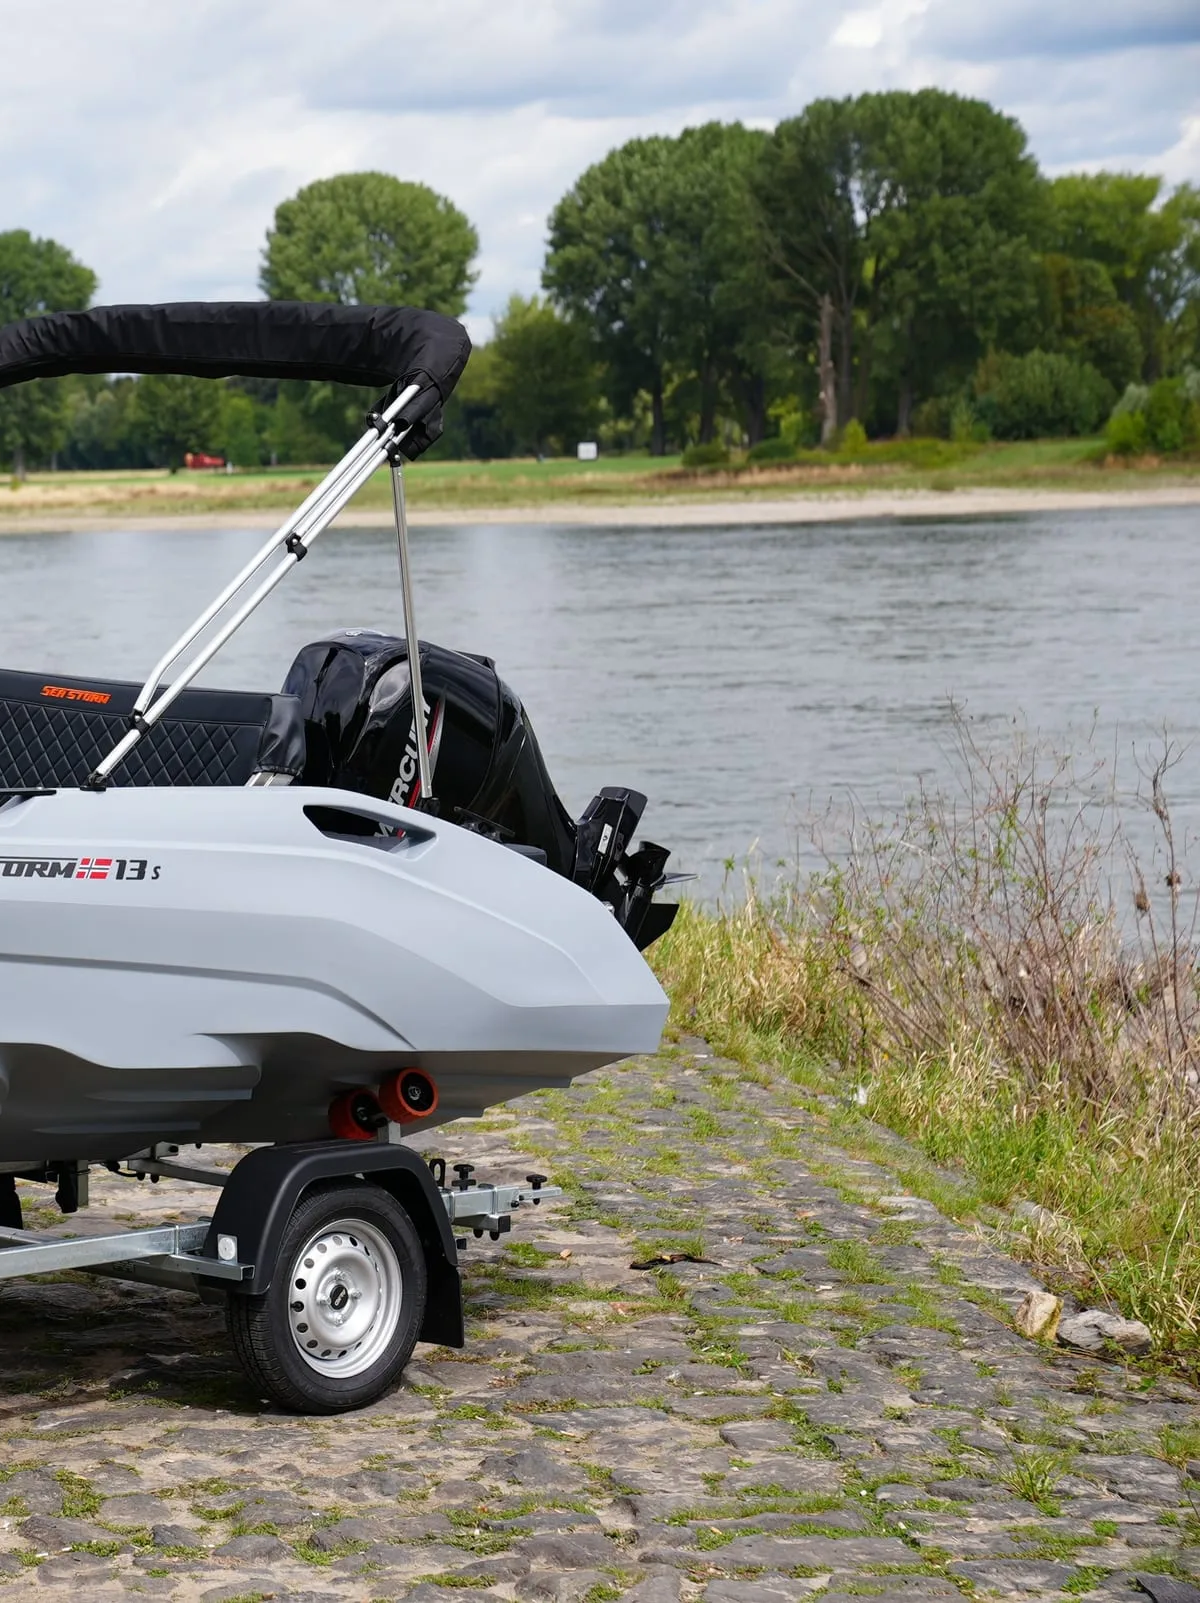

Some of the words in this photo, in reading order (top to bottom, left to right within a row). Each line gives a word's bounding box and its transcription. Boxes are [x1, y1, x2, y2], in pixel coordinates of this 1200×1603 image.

[40, 685, 67, 699] SEA
[66, 688, 112, 704] STORM
[114, 858, 148, 881] 13
